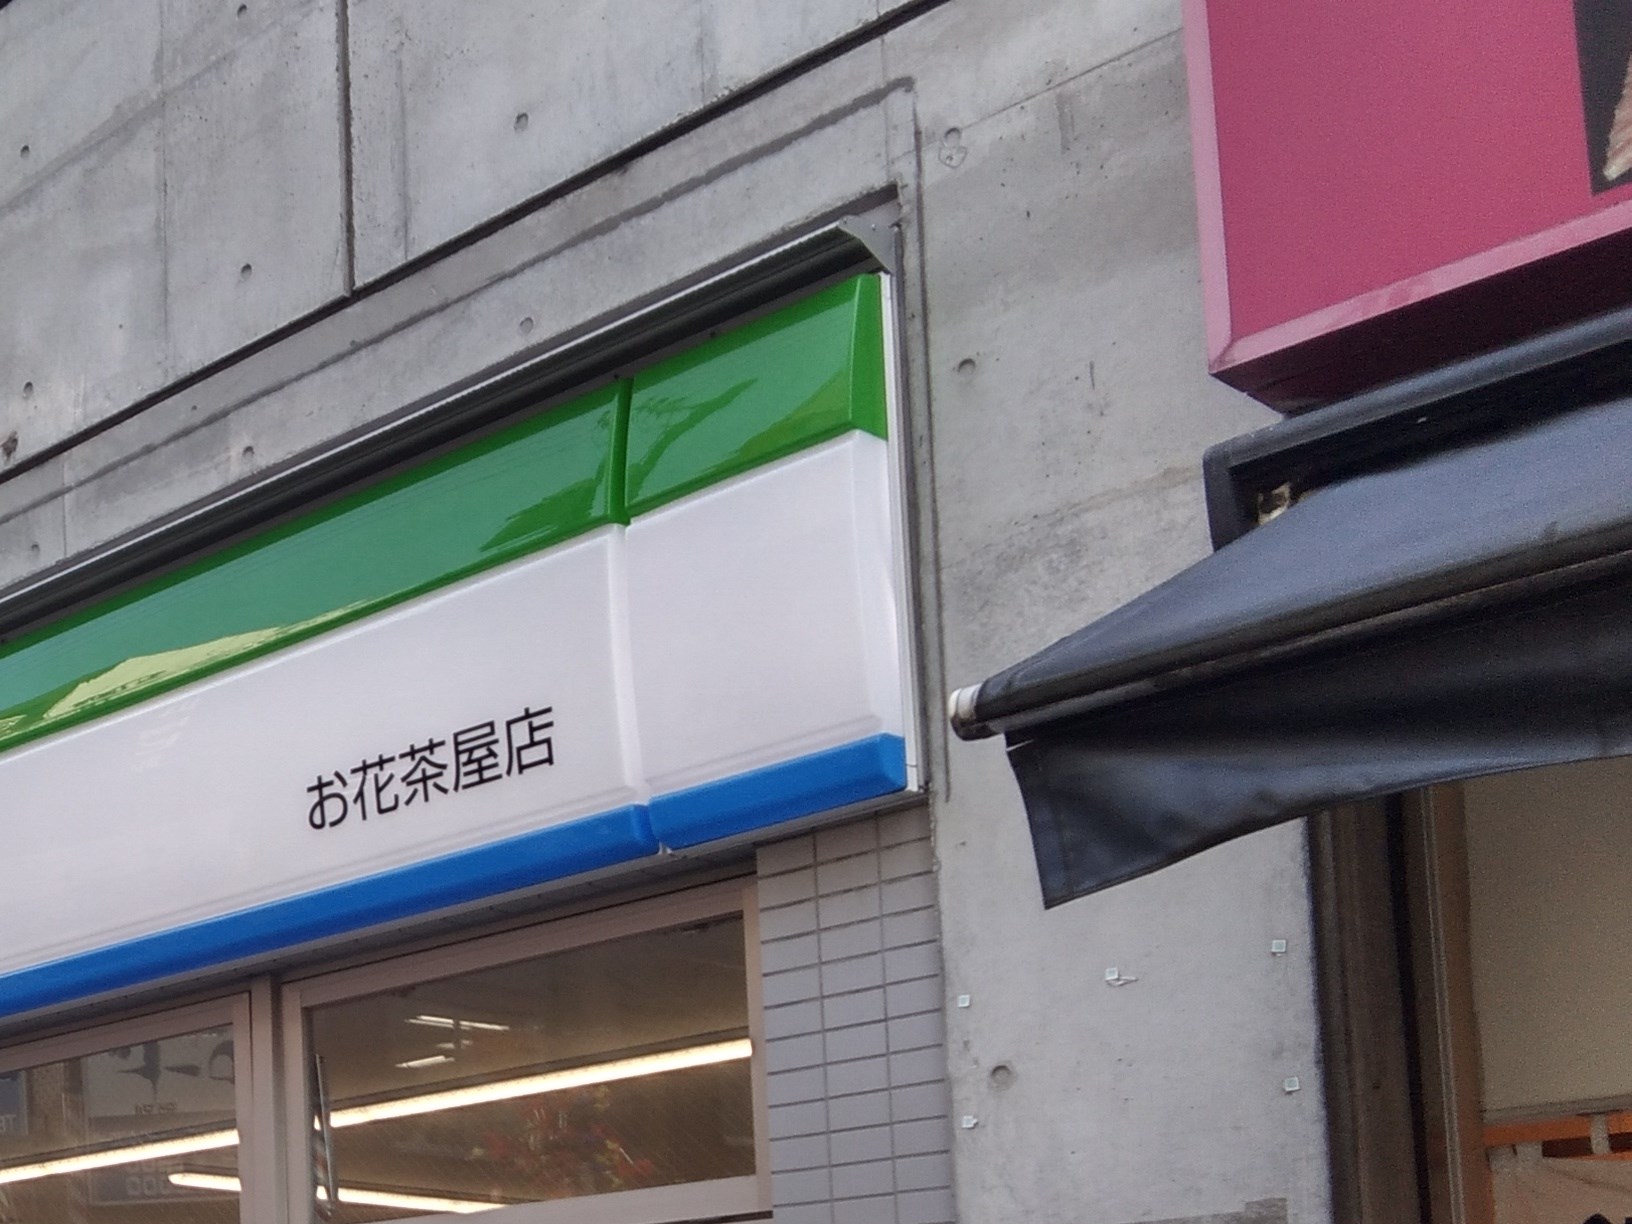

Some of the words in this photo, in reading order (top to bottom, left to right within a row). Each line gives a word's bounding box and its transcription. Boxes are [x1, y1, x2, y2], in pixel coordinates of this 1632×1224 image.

[306, 706, 555, 830] お花茶屋店
